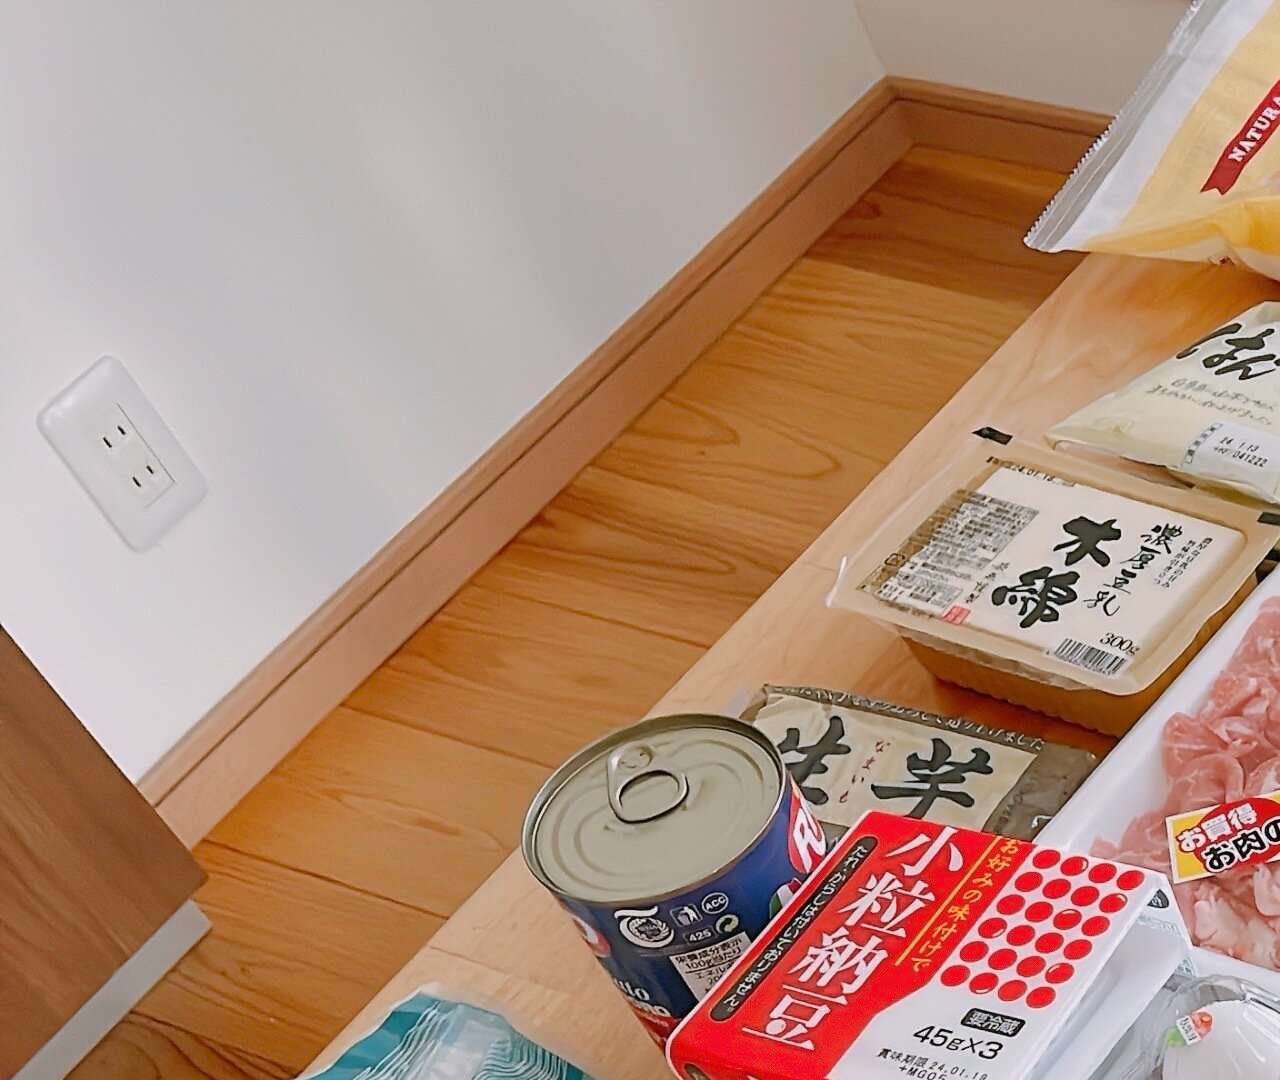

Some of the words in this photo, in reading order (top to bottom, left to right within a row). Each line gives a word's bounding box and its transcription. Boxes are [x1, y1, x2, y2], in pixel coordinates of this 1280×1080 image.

[991, 514, 1123, 629] 木綿
[1084, 523, 1185, 618] 濃厚豆乳
[1098, 631, 1142, 657] 300g
[1175, 804, 1259, 854] お買得
[704, 894, 727, 912] ACC
[909, 837, 1022, 974] お好みの味付けで
[683, 927, 714, 944] 425
[741, 825, 965, 1051] 小粒納豆
[967, 1010, 1021, 1037] 要冷蔵
